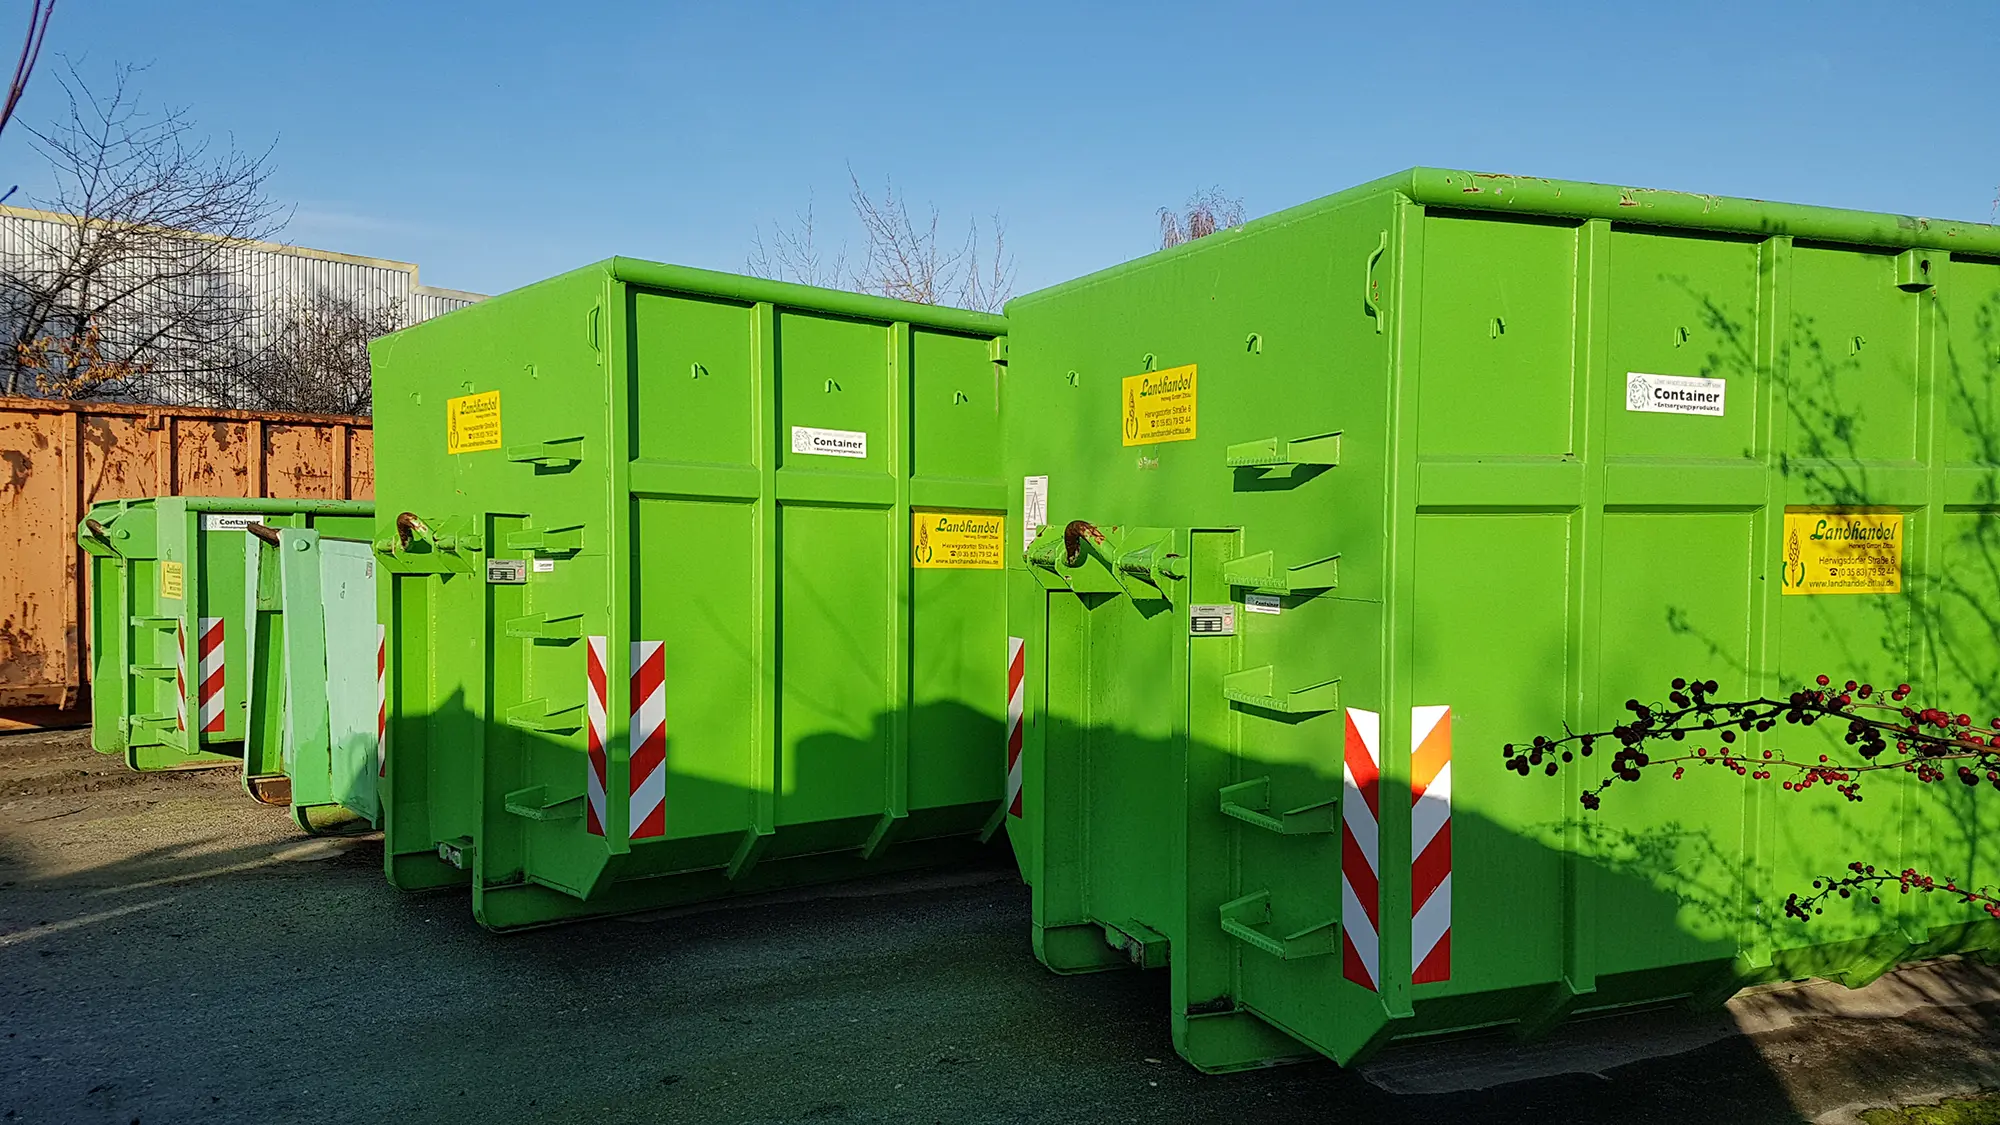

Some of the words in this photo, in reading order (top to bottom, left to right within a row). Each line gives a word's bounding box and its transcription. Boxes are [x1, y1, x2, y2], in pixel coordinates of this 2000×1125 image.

[1140, 372, 1193, 397] Landhandel
[1654, 388, 1720, 403] Container
[814, 437, 862, 448] Container
[935, 518, 999, 533] Landhandel
[1810, 519, 1898, 540] Landhandel
[1868, 556, 1889, 564] Straße
[1891, 556, 1895, 564] 6
[1877, 568, 1885, 576] 52
